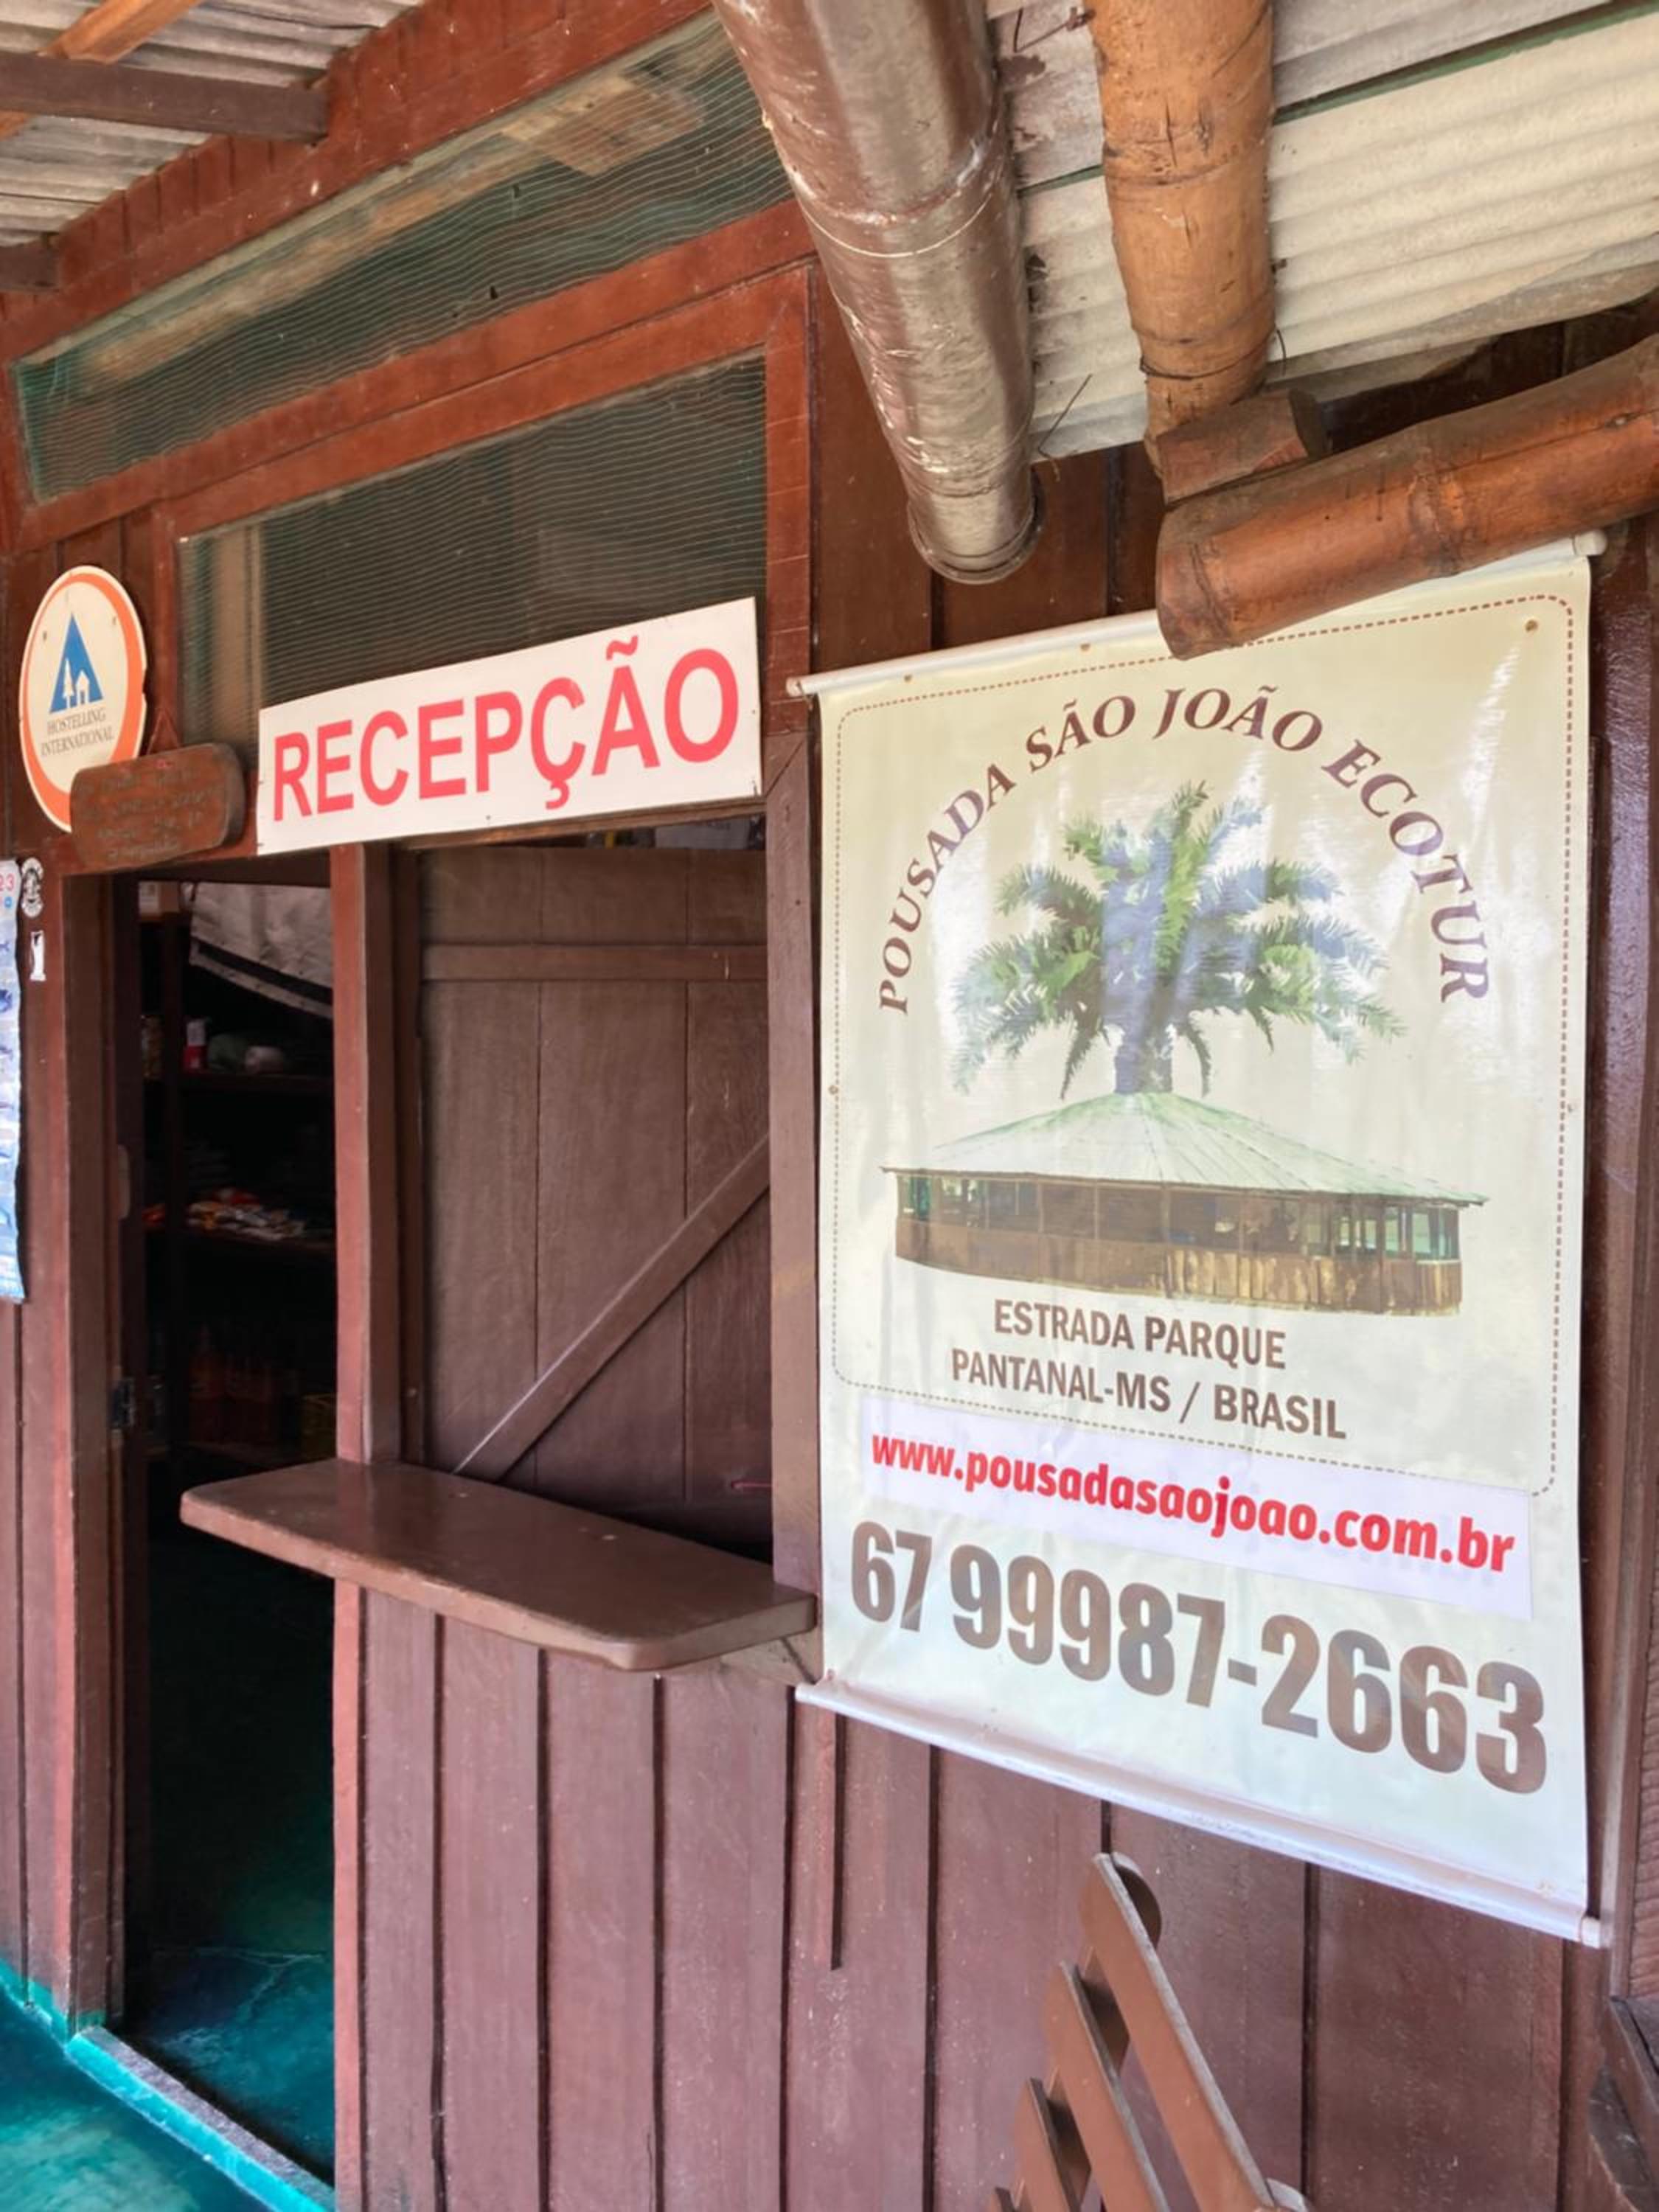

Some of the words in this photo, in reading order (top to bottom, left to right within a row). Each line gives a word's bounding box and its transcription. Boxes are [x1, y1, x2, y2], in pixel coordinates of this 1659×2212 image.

[46, 707, 105, 735] HOSTELLING
[273, 635, 738, 821] RECEPÇÃO
[880, 762, 1015, 1014] POUSADA
[1026, 695, 1136, 771] SÃO
[1152, 685, 1322, 752] JOÃO
[1321, 739, 1489, 1004] ECOTUR
[951, 1348, 1171, 1412] PANTANAL-MS
[1214, 1383, 1346, 1440] BRASIL
[994, 1299, 1134, 1350] ESTRADA
[1144, 1316, 1286, 1370] PARQUE
[871, 1431, 1515, 1573] www.pousadasaojoao.com.br
[852, 1520, 932, 1632] 67
[950, 1543, 1548, 1795] 99987-2663
